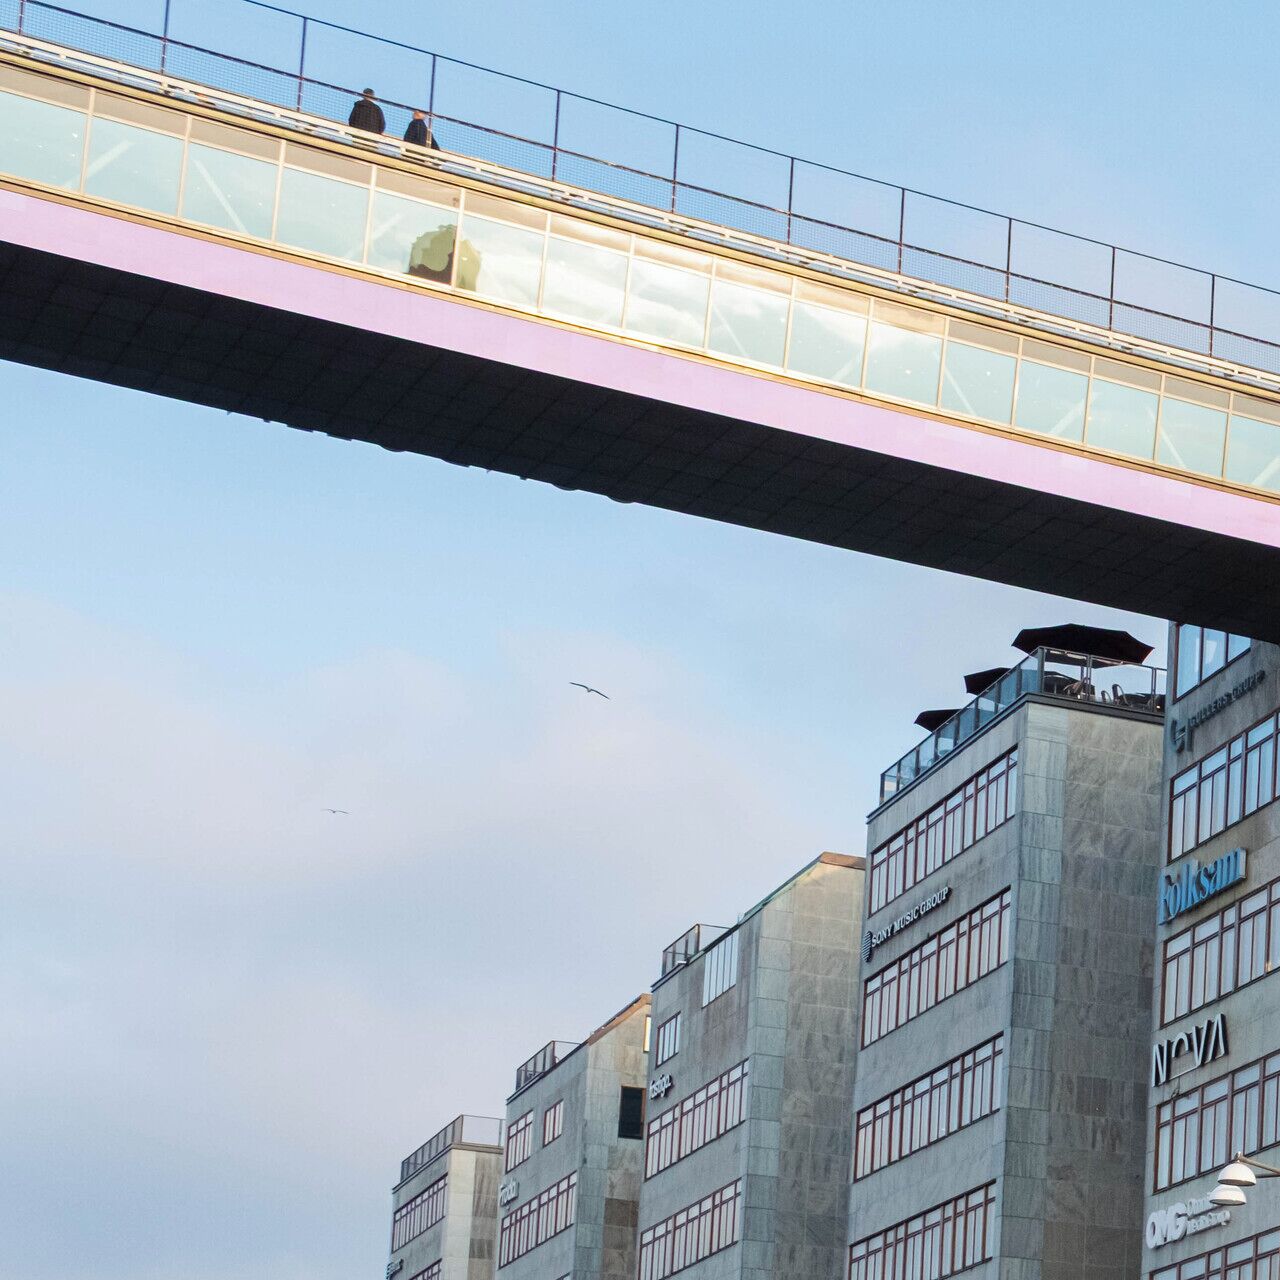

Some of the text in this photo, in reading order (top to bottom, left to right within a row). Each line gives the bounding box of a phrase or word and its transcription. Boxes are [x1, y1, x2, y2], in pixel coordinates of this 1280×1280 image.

[871, 886, 950, 948] SONY MUSIC GROUP
[1159, 847, 1246, 926] Folksam
[1151, 1013, 1228, 1088] NOVA
